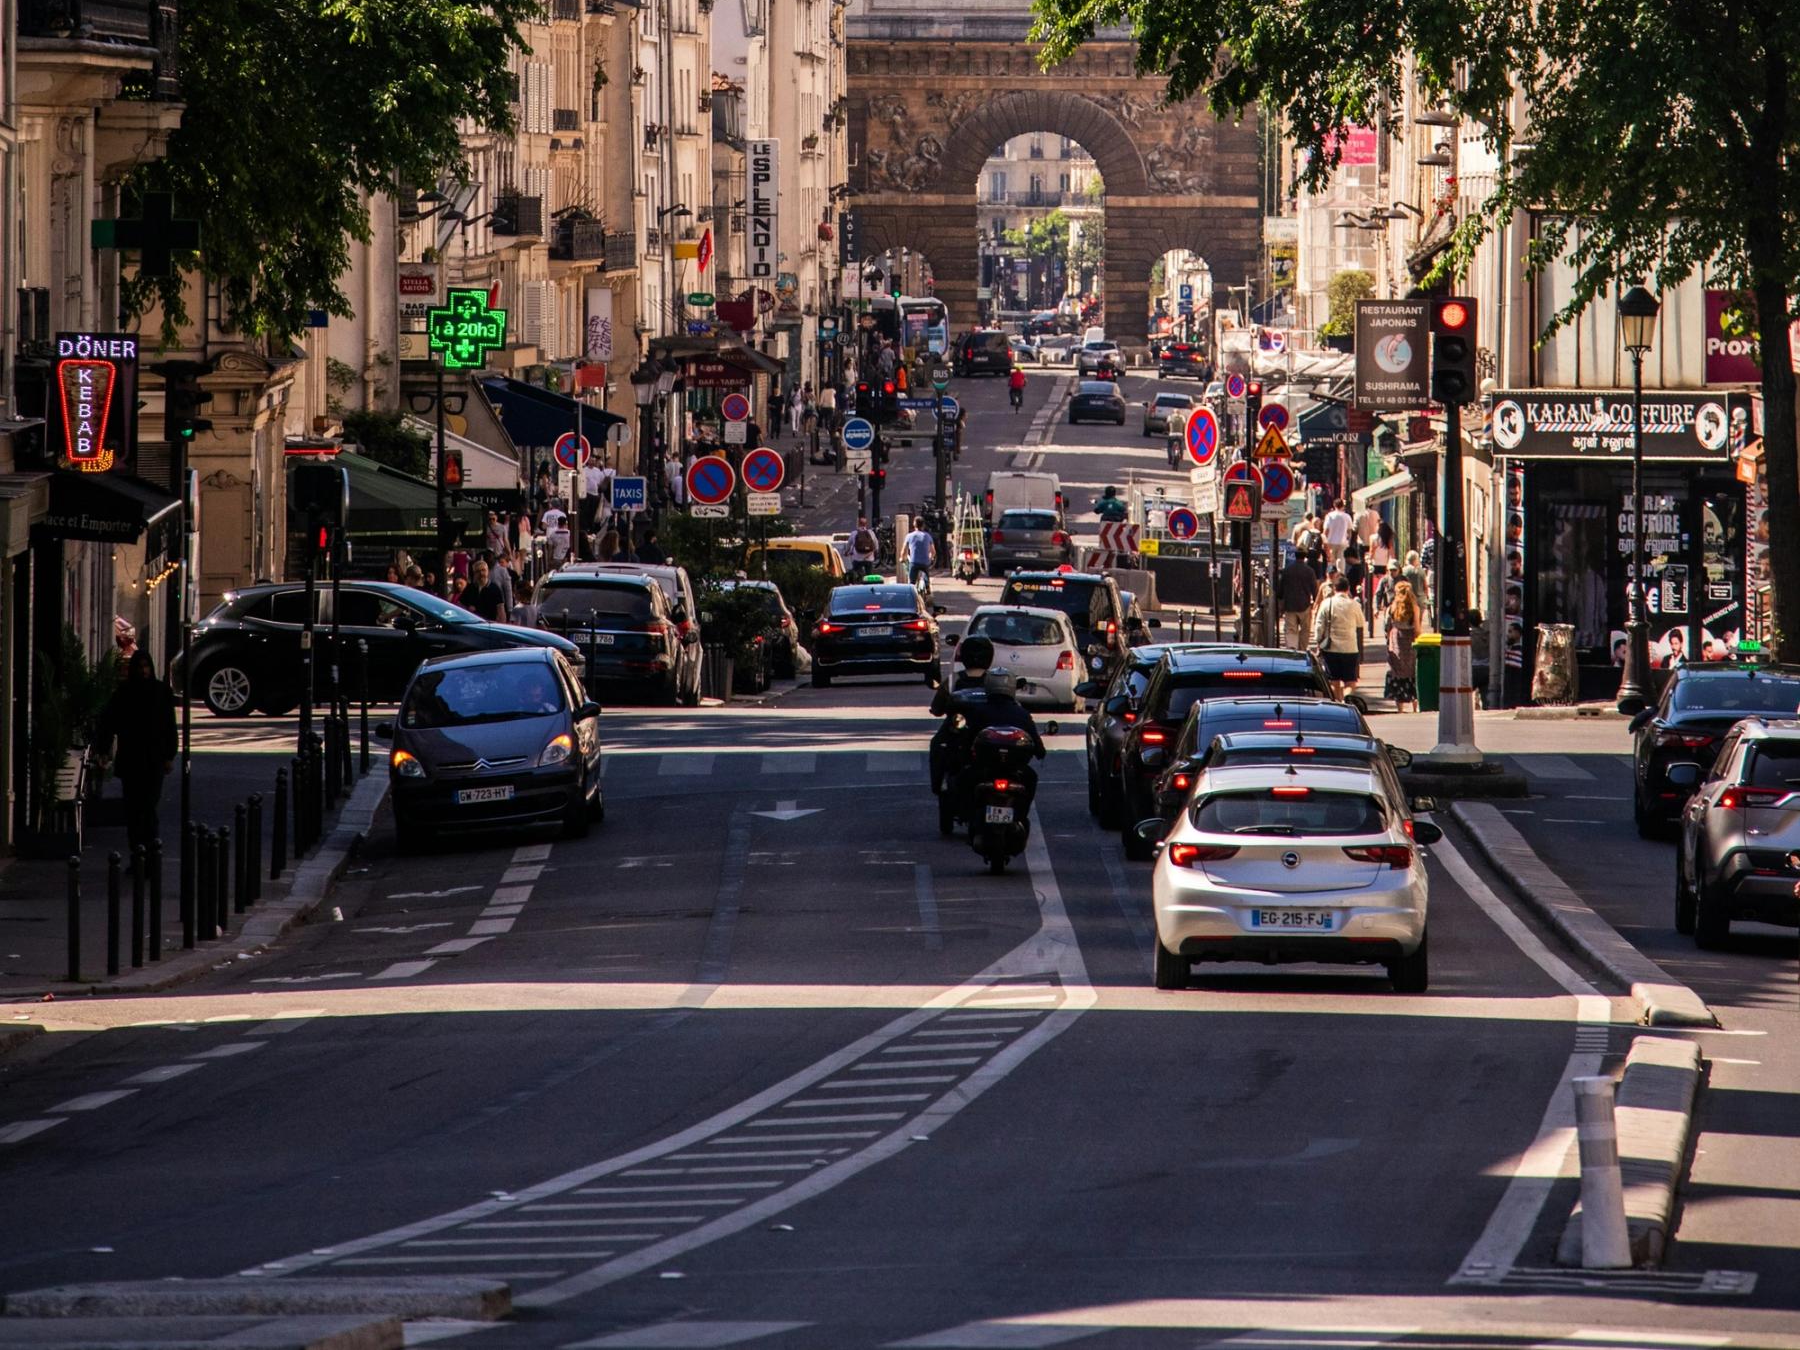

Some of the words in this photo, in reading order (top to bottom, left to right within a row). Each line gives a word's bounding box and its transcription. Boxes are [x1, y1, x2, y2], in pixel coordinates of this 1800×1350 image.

[753, 144, 770, 155] LE
[753, 158, 770, 277] SPLENDID
[1361, 306, 1424, 315] RESTAURANT
[443, 321, 454, 336] à
[457, 323, 497, 338] 20h3
[1370, 319, 1417, 327] JAPONAIS
[59, 335, 135, 358] DÖNER
[933, 370, 949, 379] BUS
[1365, 382, 1421, 391] SUSHIRAMA
[1358, 396, 1375, 404] TEL.
[77, 369, 93, 452] KEBAB
[1526, 403, 1591, 424] KARAN
[1609, 403, 1695, 425] COFFURE
[615, 488, 643, 499] TAXIS
[1623, 494, 1675, 511] KRAN
[67, 514, 78, 528] et
[80, 513, 132, 534] Emporter
[1618, 513, 1680, 533] COFFURE
[460, 787, 507, 802] GW-723-HY
[1261, 912, 1324, 926] EG-215-FJ
